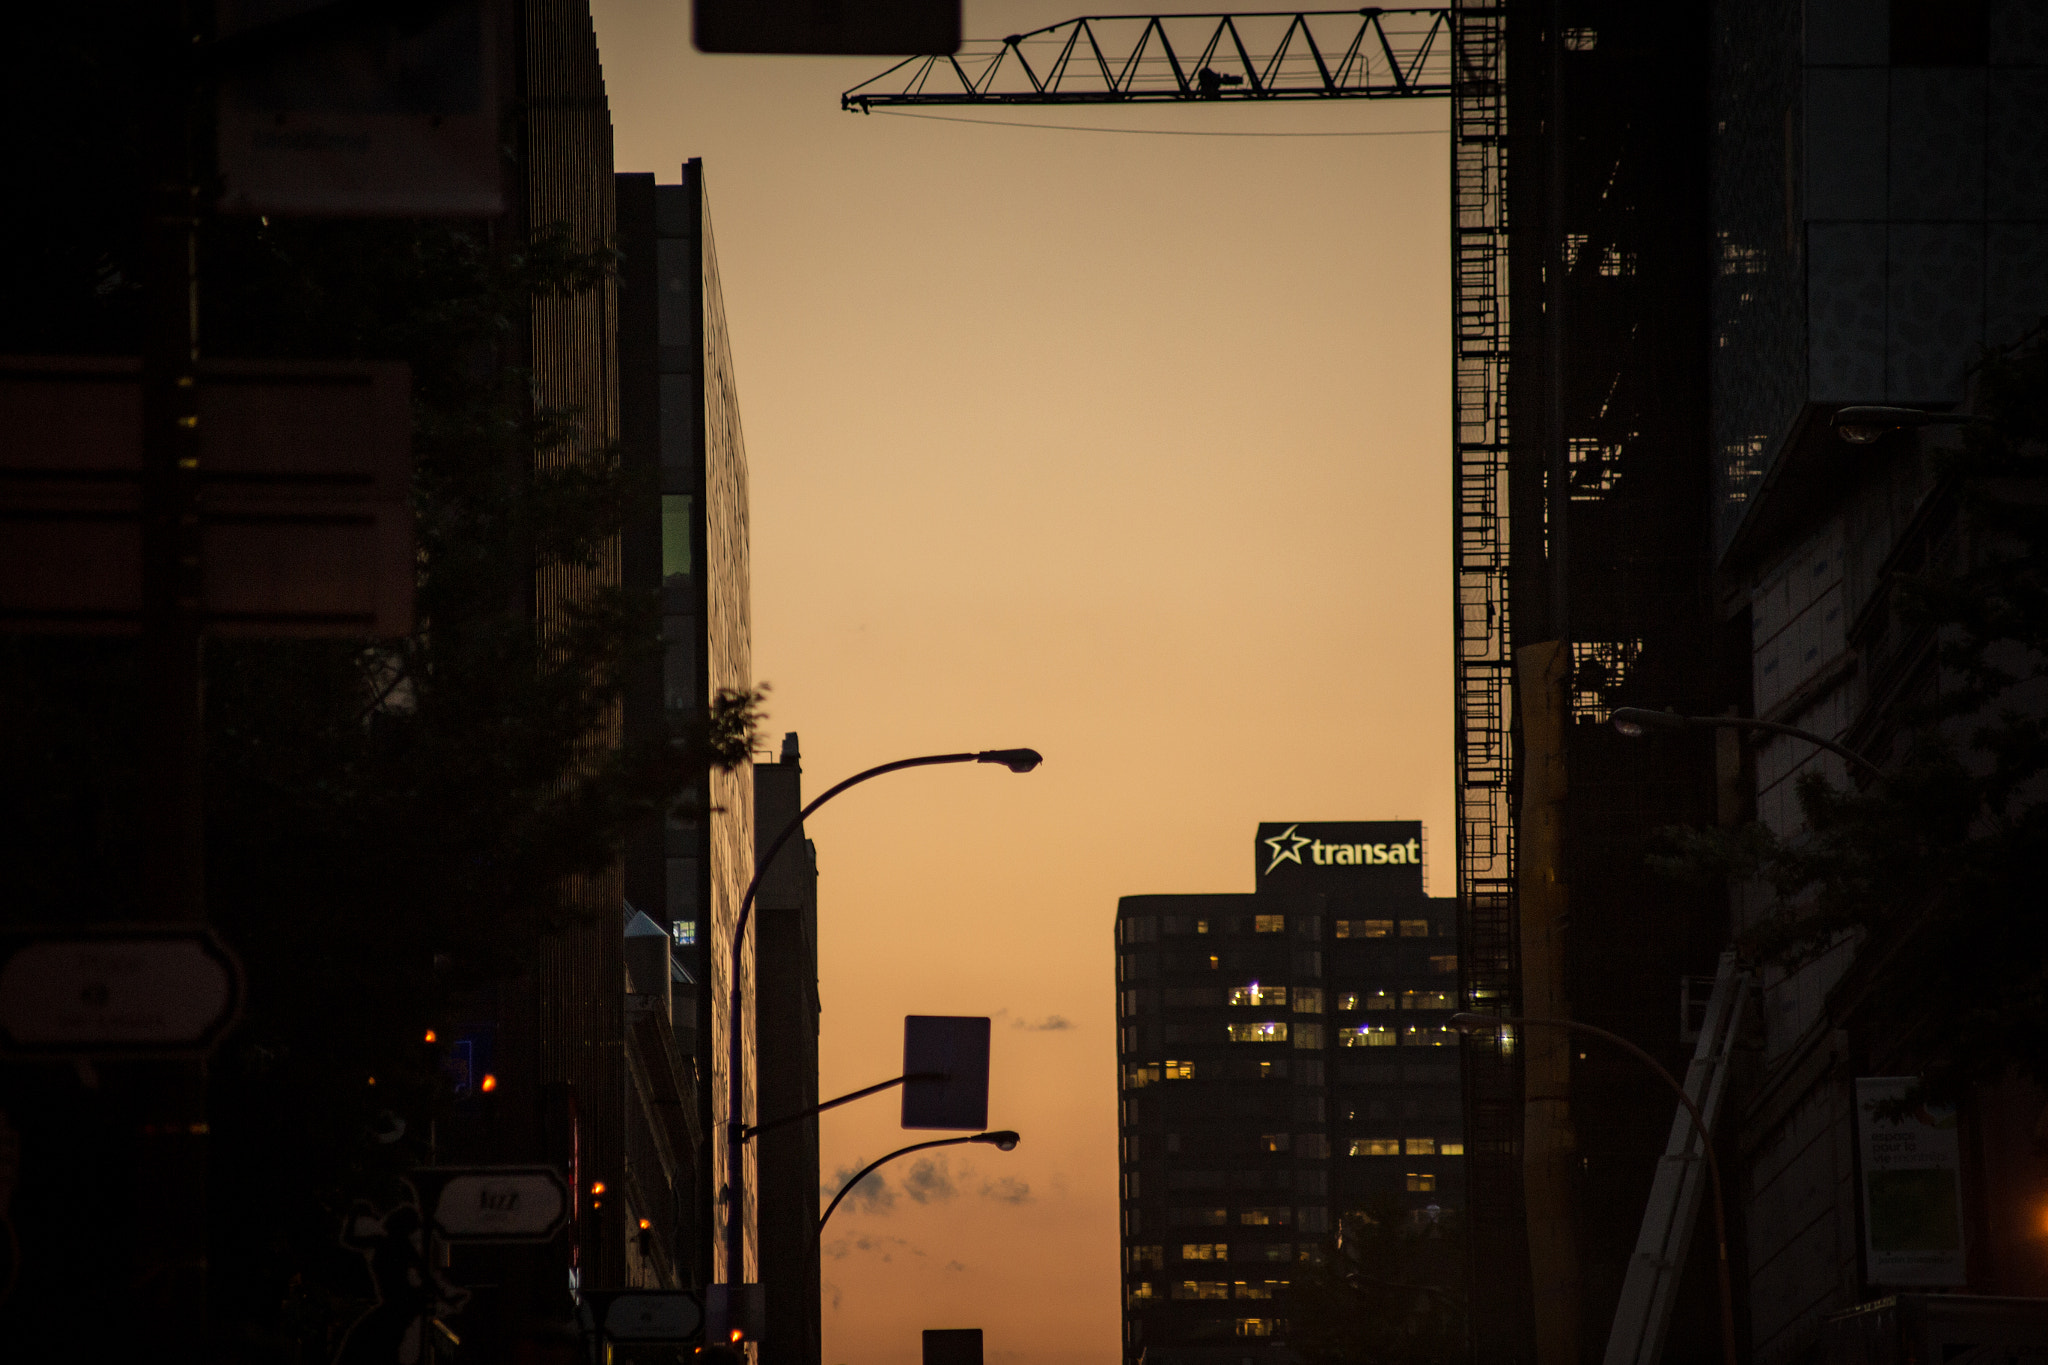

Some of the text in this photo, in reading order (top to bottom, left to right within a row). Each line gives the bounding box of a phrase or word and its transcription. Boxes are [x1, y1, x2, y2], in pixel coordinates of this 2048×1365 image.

[1310, 837, 1421, 866] transat
[1871, 1132, 1915, 1143] espace
[1872, 1140, 1916, 1154] pour la
[1873, 1153, 1892, 1163] vie
